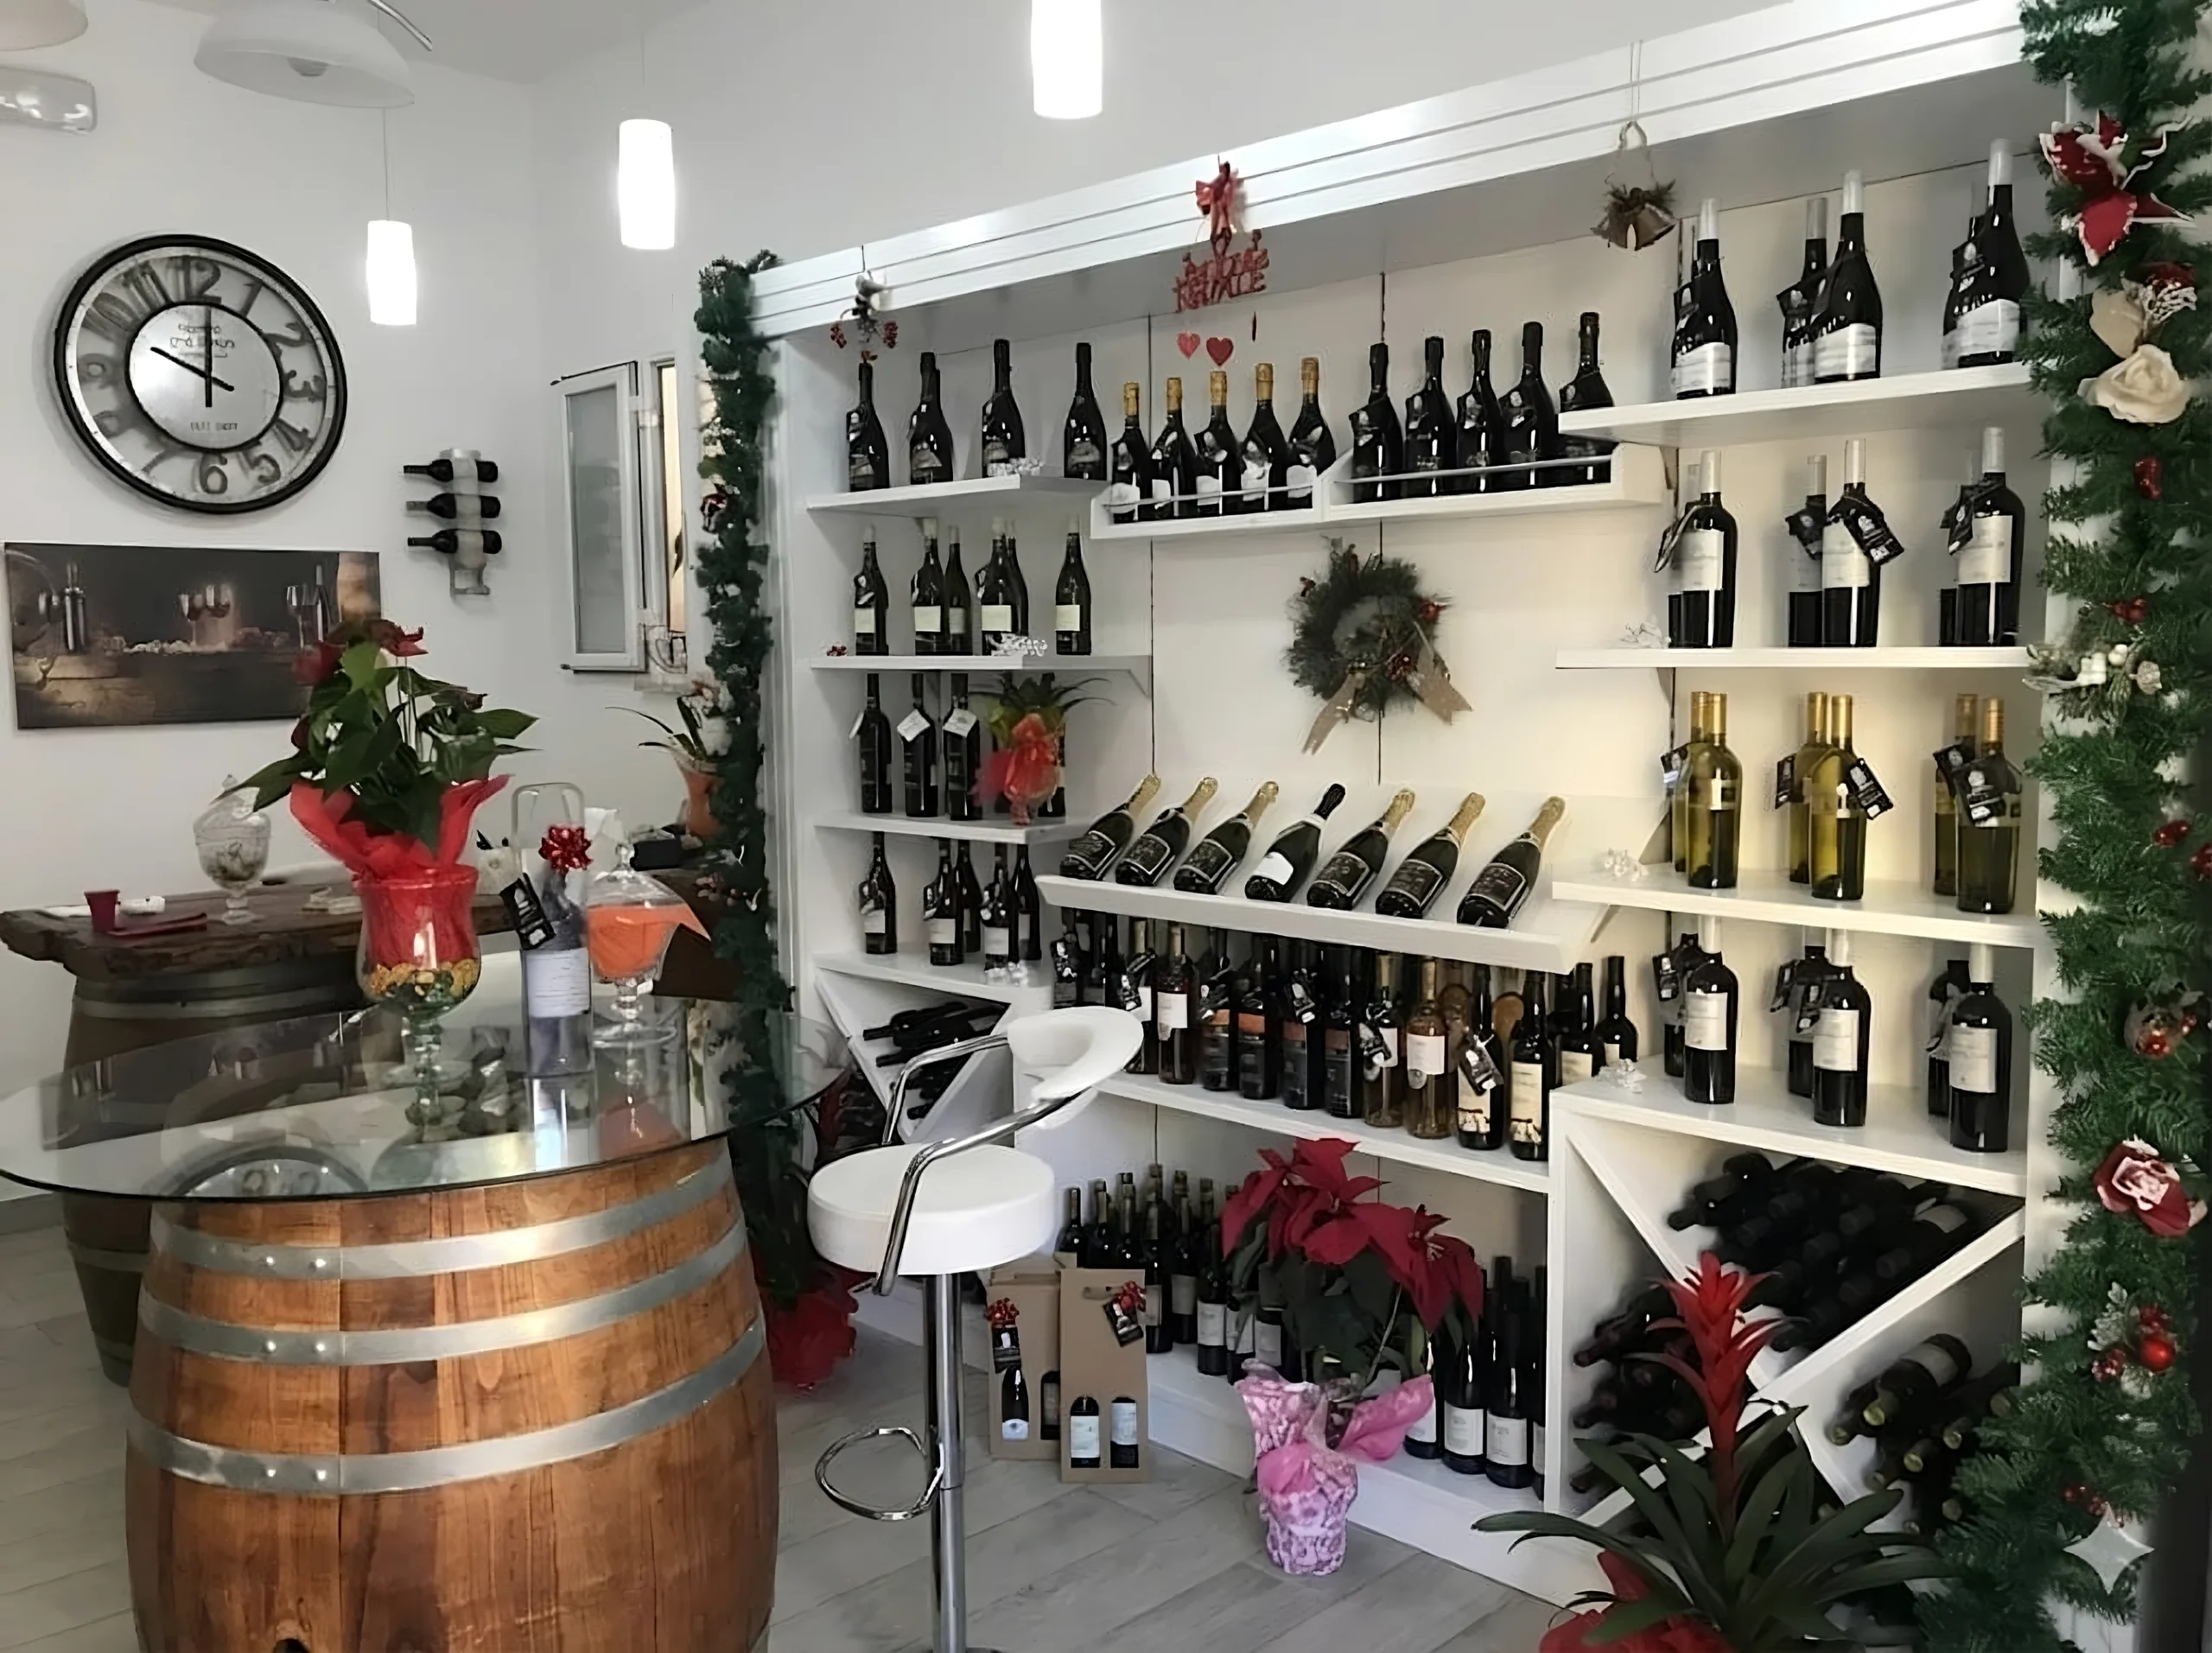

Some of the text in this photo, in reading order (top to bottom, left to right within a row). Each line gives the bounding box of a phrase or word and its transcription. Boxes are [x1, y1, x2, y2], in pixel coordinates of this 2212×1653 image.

[175, 256, 221, 303] 12
[243, 278, 263, 318] 1
[264, 322, 313, 347] 2
[283, 370, 327, 403] 3
[199, 451, 228, 494] 6
[243, 442, 281, 485] 5
